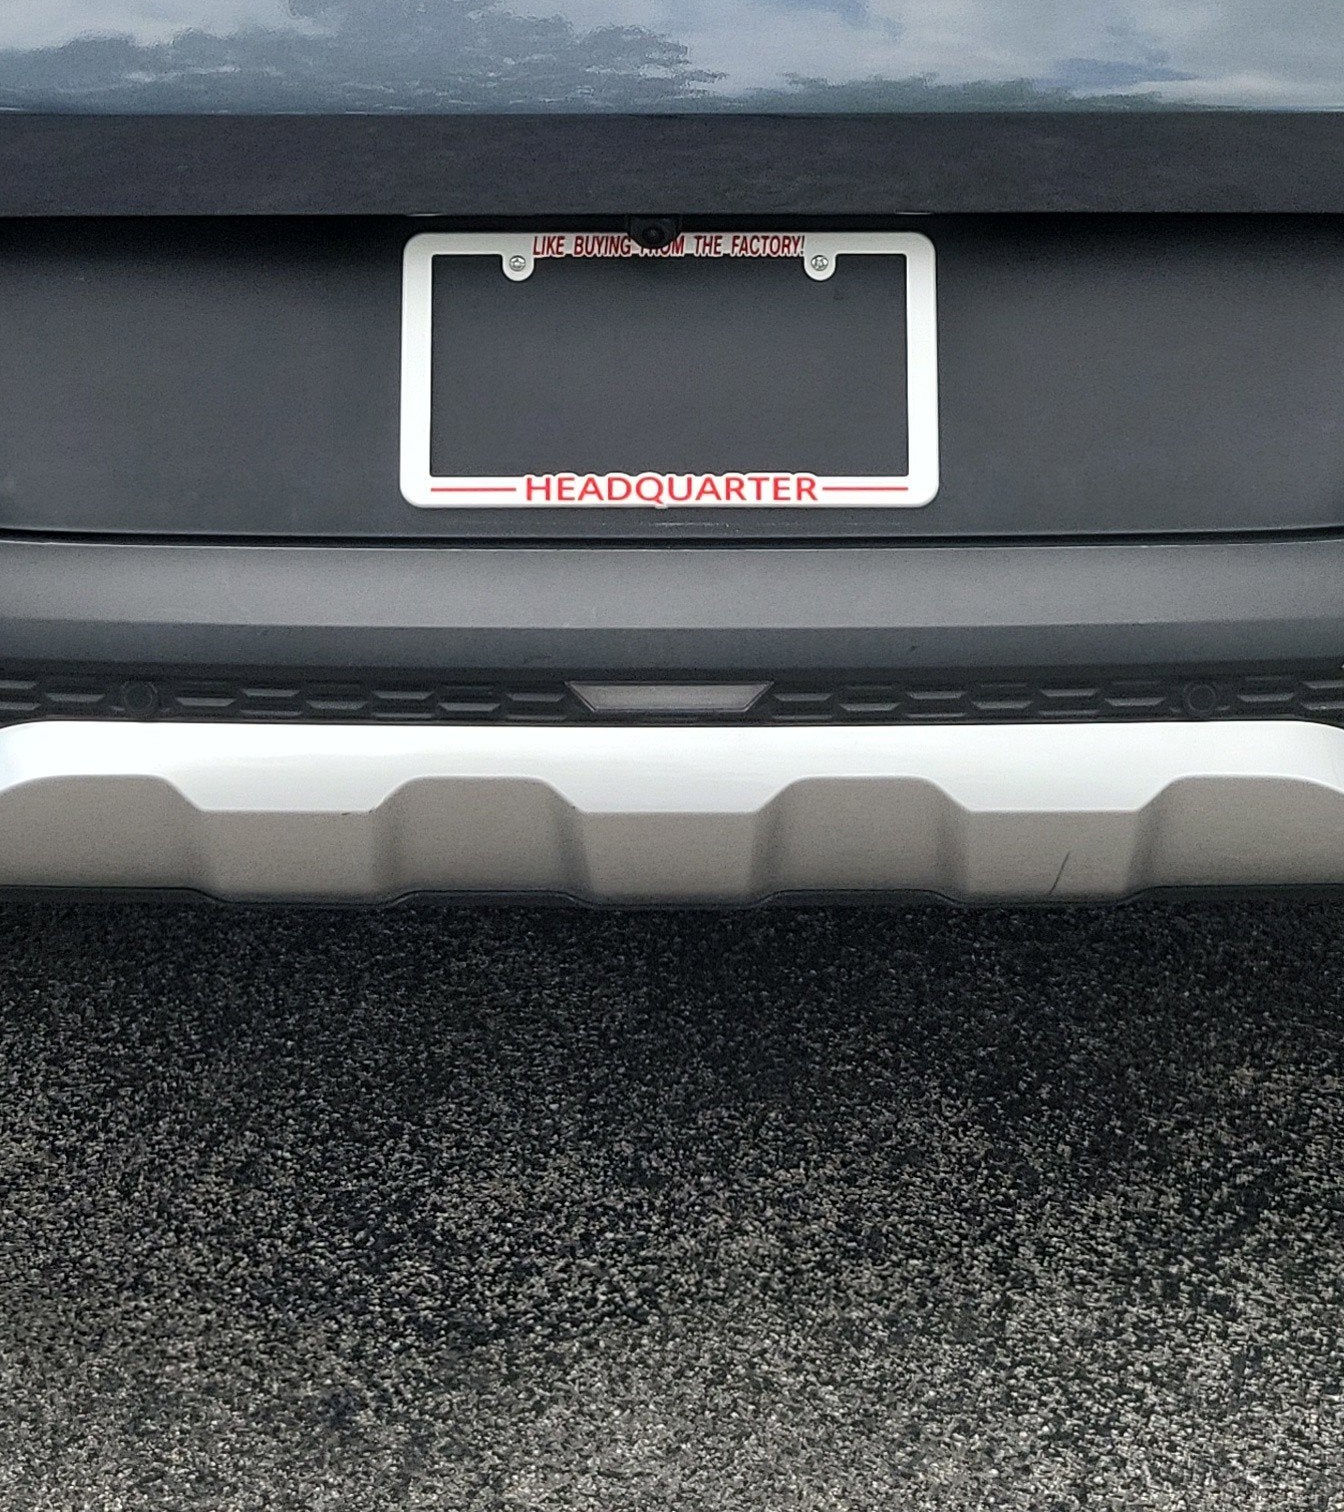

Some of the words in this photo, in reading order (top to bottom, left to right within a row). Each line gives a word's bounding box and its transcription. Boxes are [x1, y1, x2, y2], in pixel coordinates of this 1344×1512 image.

[533, 235, 565, 256] LIKE
[574, 235, 631, 256] BUYING
[694, 235, 722, 256] THE
[731, 235, 805, 256] FACTORY!
[525, 476, 818, 504] HEADQUARTER
